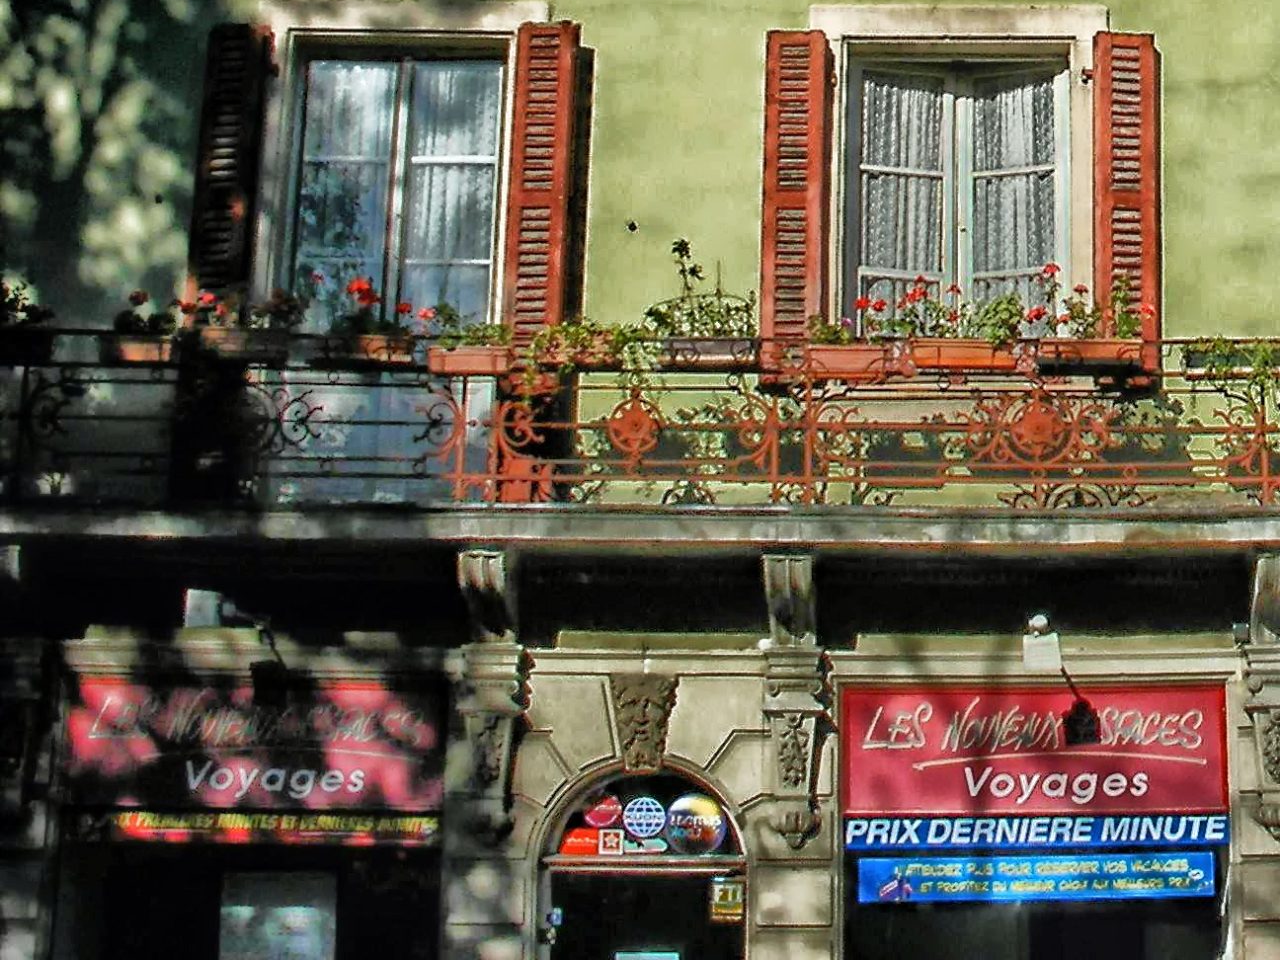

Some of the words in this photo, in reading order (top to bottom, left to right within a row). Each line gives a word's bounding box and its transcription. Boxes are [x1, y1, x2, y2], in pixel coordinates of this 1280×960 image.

[861, 702, 933, 751] LES
[941, 696, 1063, 754] NOUVEAUX
[1072, 706, 1204, 751] SPACES
[185, 759, 366, 800] Voyages
[963, 766, 1151, 806] Voyages
[846, 818, 924, 845] PRIX
[926, 816, 1094, 844] DERNIERE
[1101, 816, 1228, 842] MINUTE
